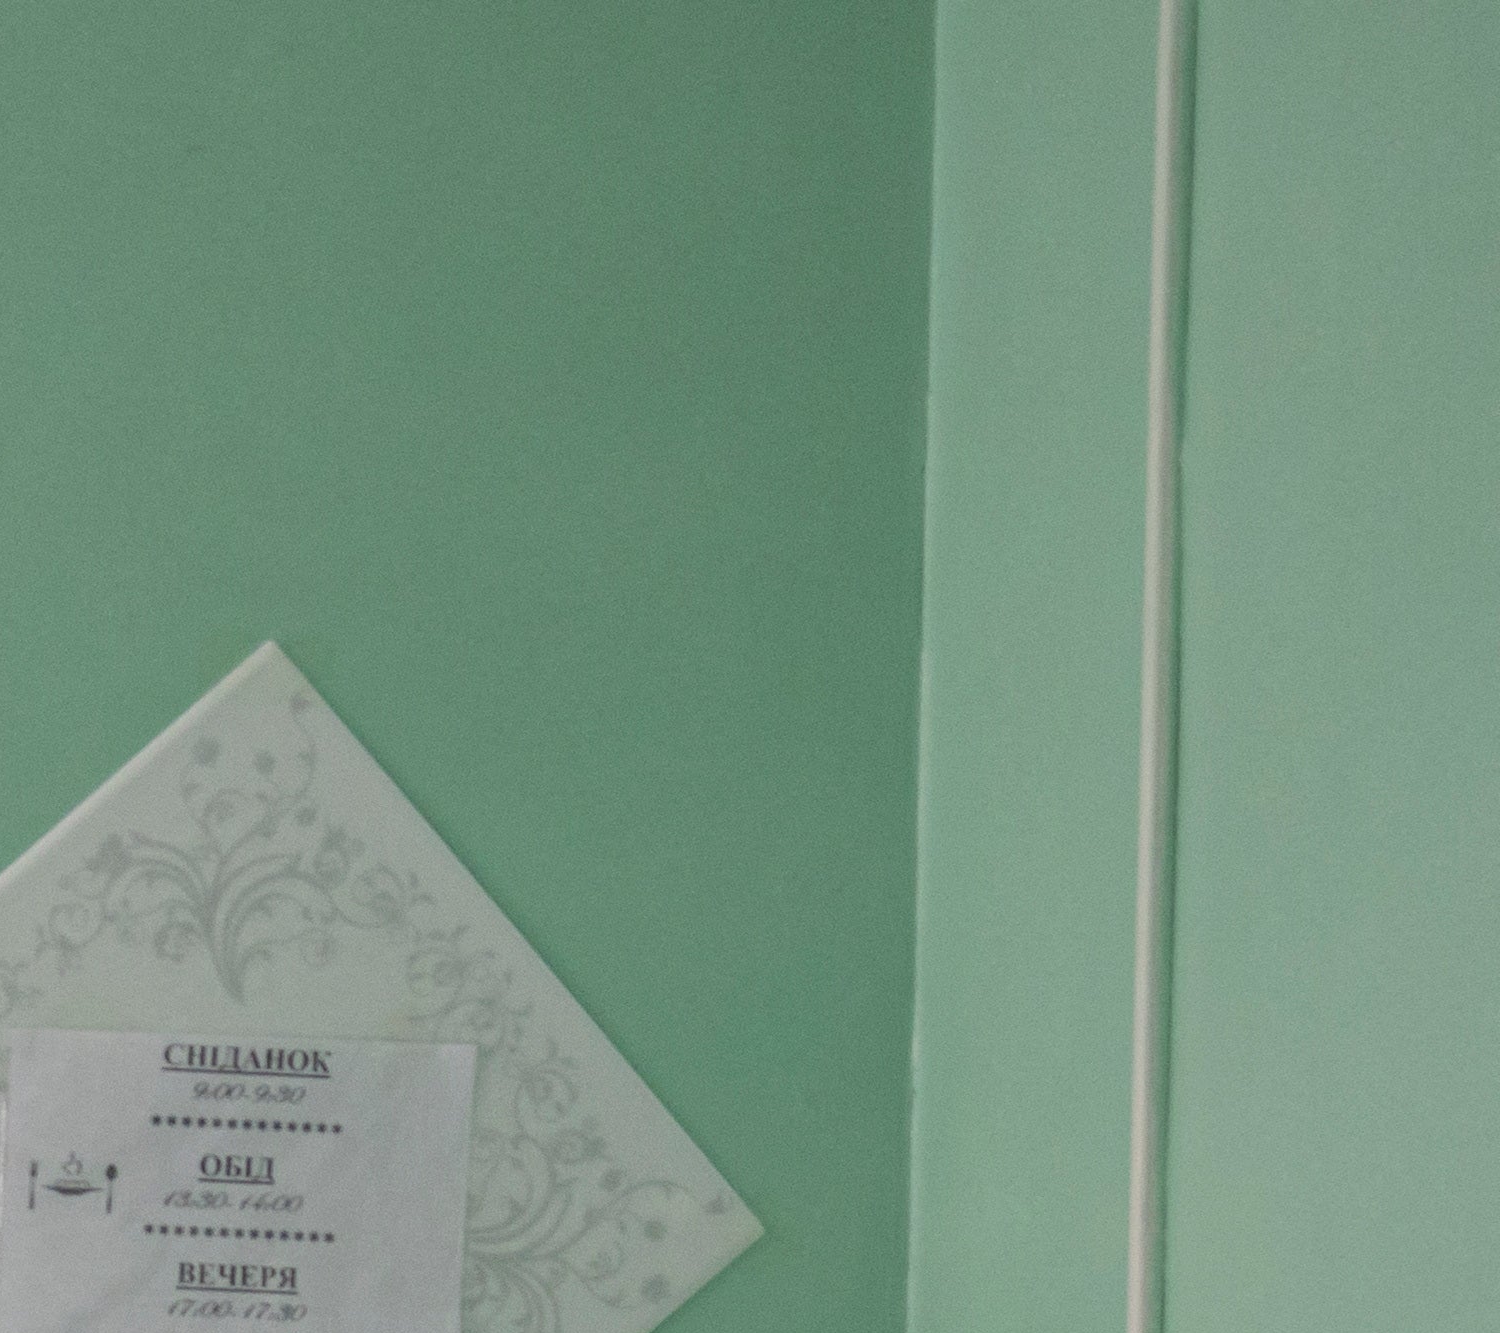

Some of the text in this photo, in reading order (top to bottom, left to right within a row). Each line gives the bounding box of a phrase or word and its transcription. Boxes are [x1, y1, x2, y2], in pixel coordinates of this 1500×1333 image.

[162, 1042, 332, 1075] СНІДАНОК
[198, 1153, 275, 1183] ОБІД
[176, 1261, 298, 1290] ВЕЧЕРЯ
